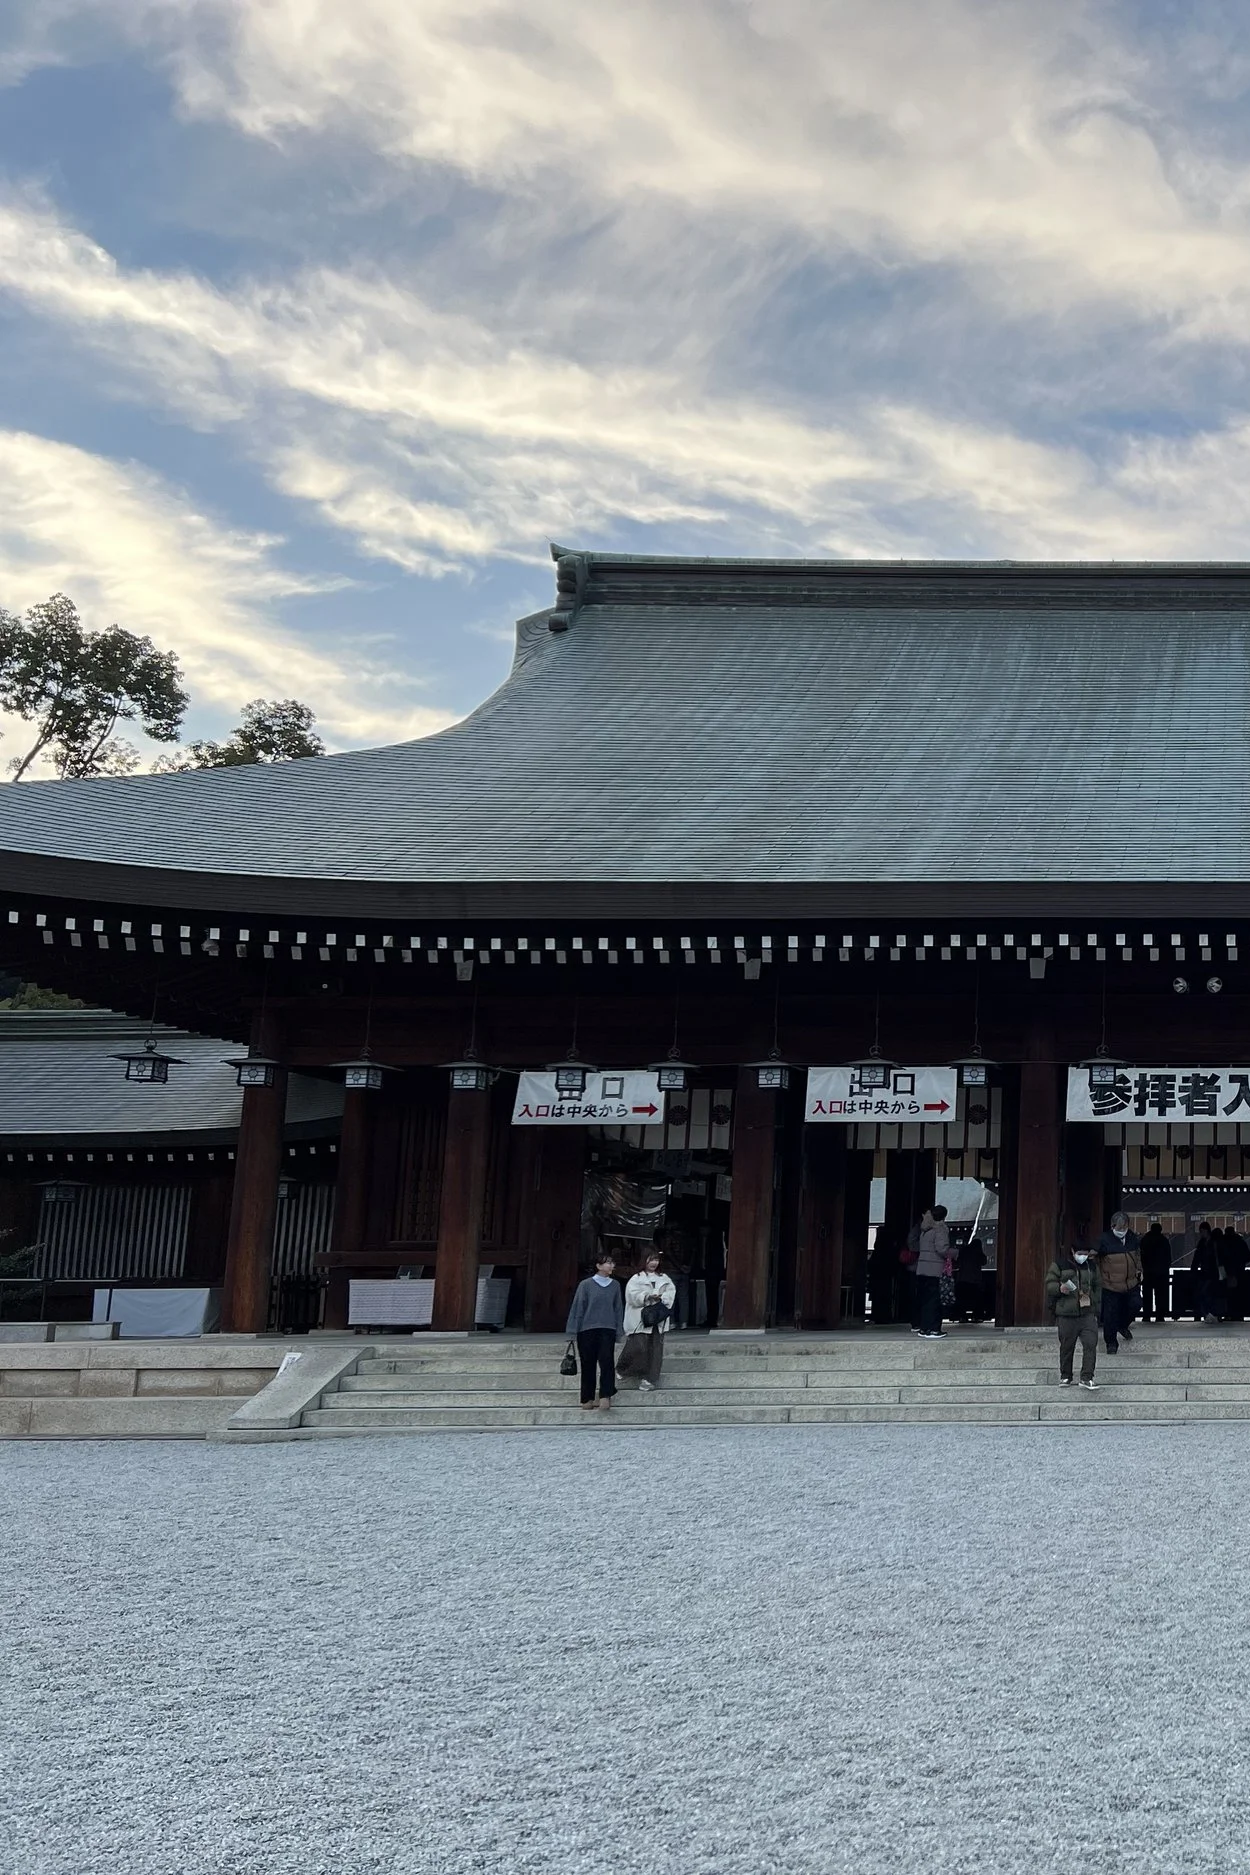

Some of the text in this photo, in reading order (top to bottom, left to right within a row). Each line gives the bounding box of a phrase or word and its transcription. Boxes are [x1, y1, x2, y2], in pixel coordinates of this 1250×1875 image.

[519, 1104, 628, 1118] 入口は中央から
[812, 1100, 920, 1114] 入口は中央から
